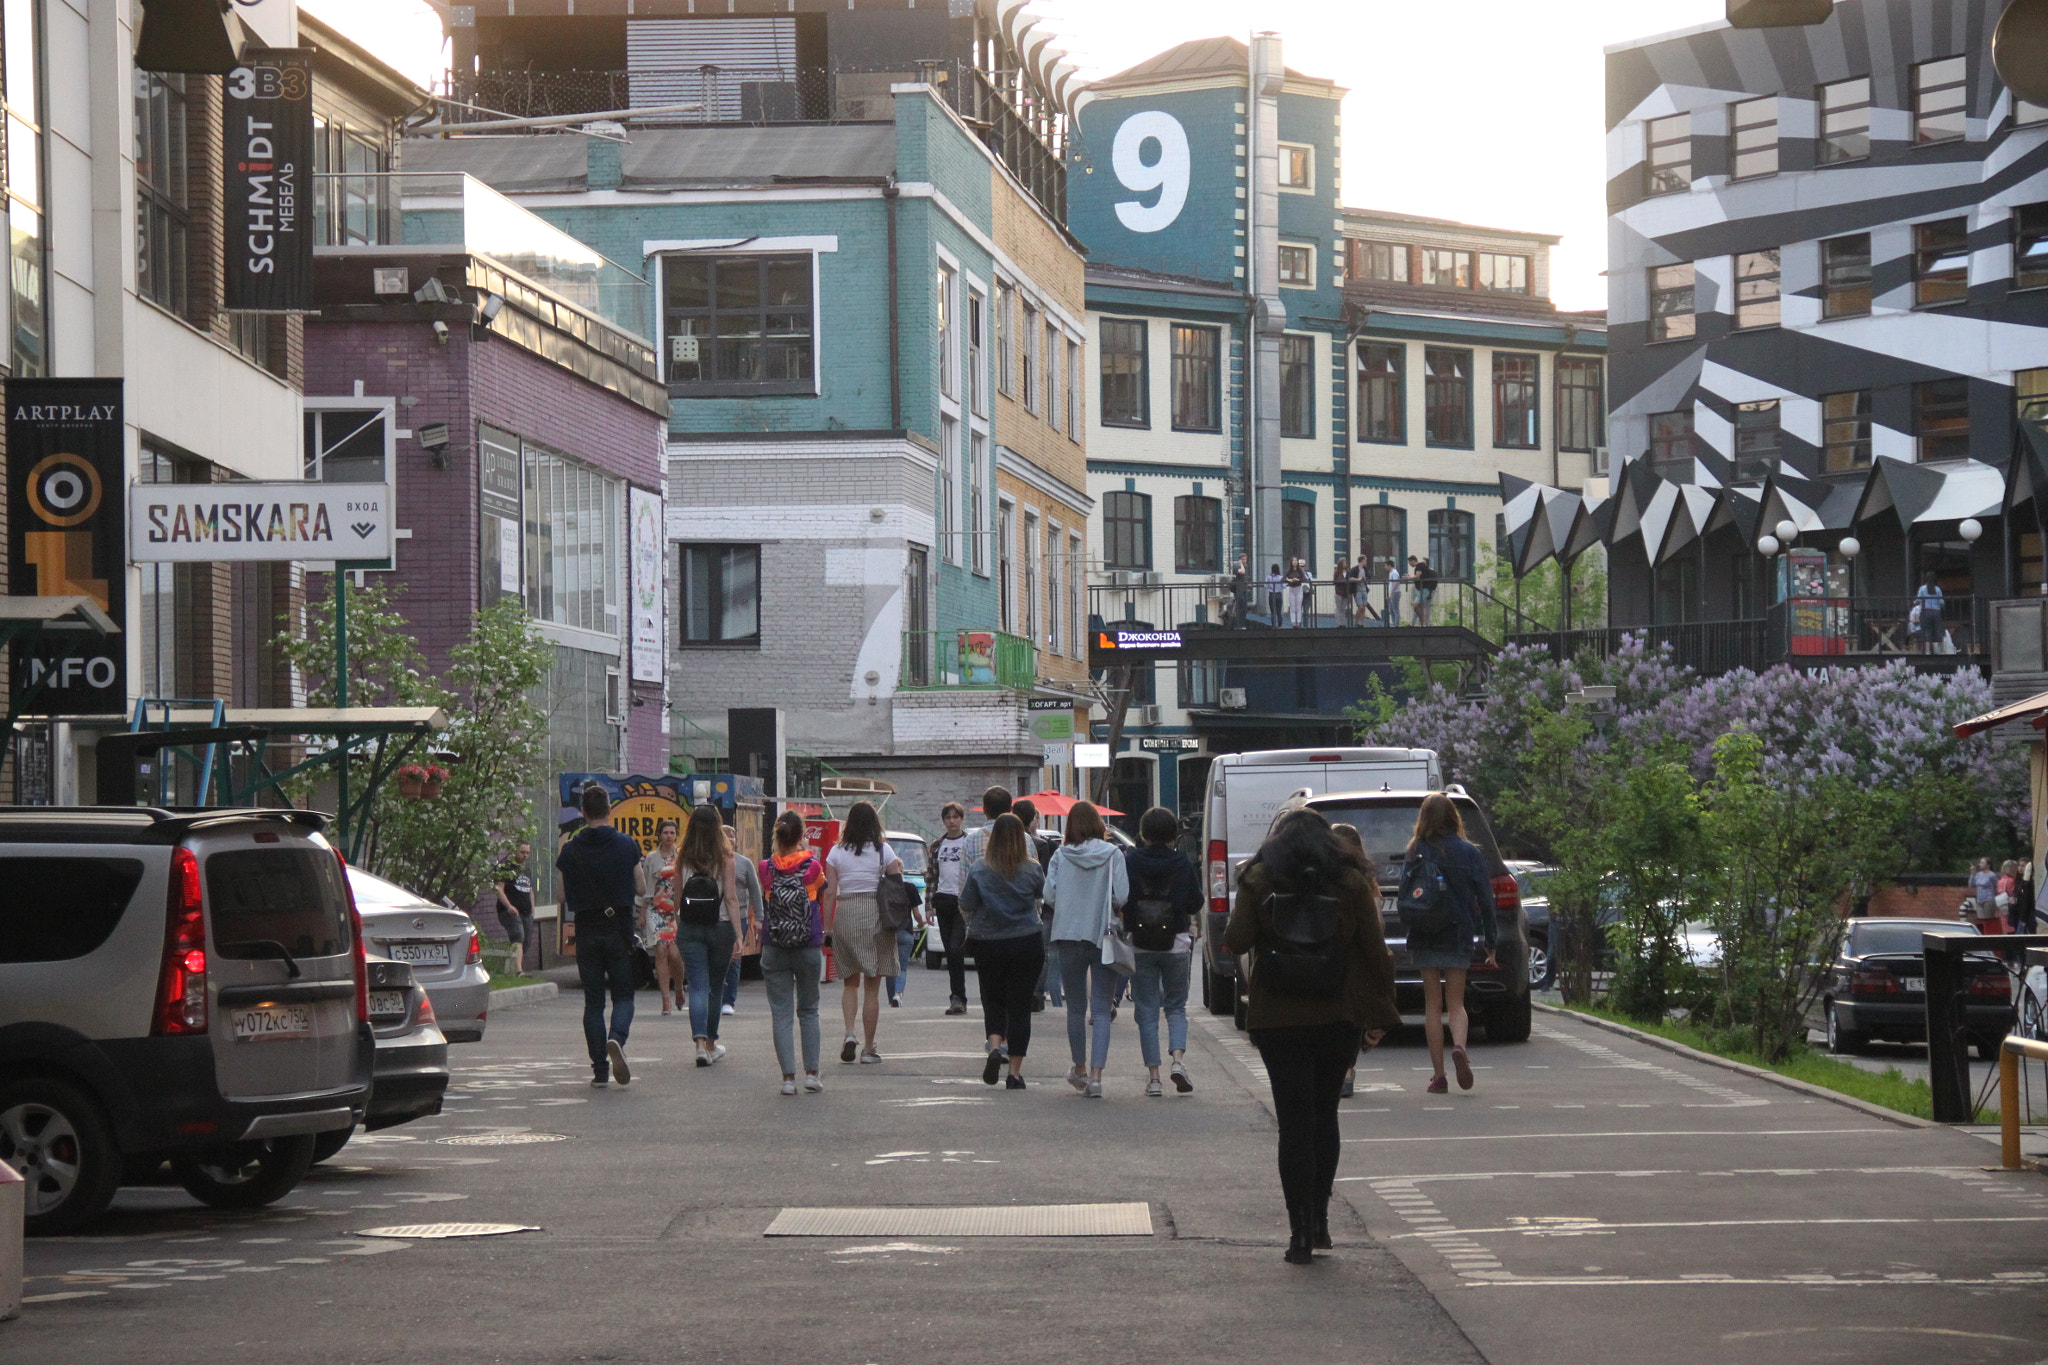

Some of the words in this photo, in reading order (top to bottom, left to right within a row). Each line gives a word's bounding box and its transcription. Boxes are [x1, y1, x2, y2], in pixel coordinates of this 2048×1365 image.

[1112, 110, 1190, 232] 9
[279, 162, 294, 232] МЕБЕЛЬ
[14, 405, 115, 420] ARTPLAY
[346, 502, 379, 512] ВХОД
[148, 502, 333, 543] SAMSKARA
[640, 803, 656, 813] THE
